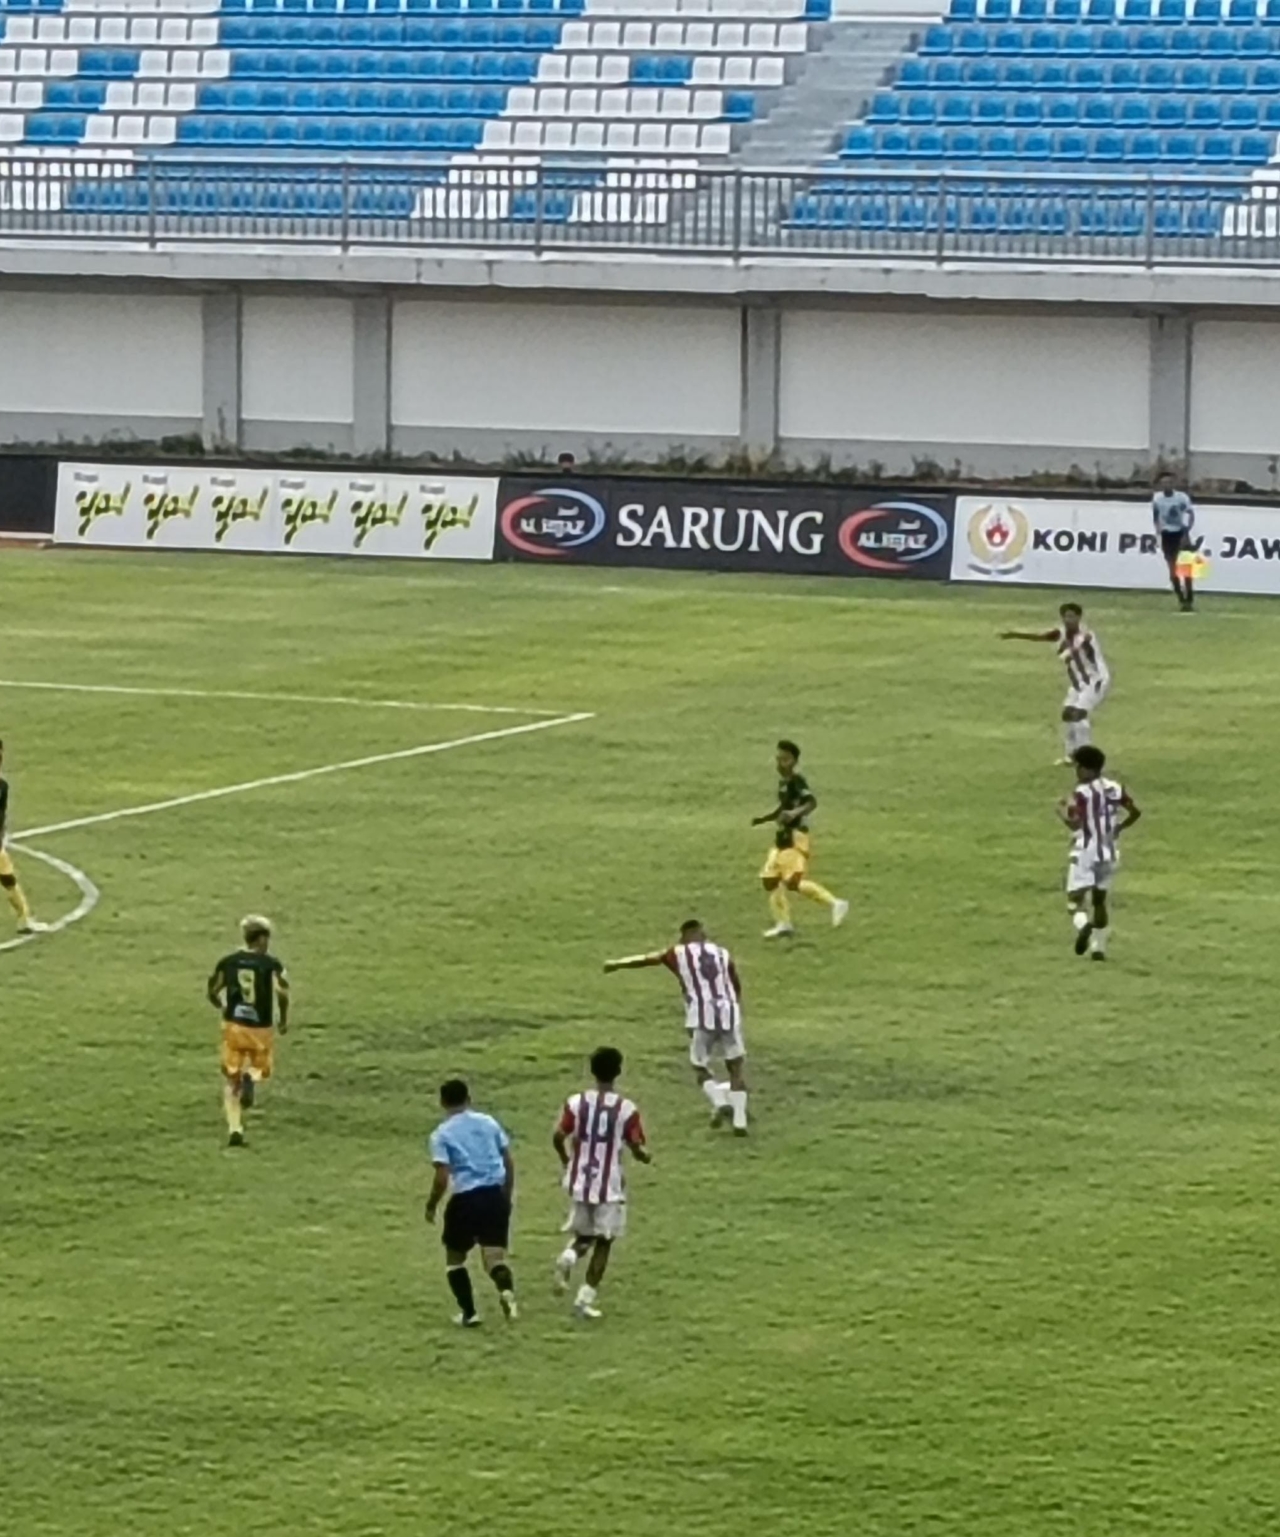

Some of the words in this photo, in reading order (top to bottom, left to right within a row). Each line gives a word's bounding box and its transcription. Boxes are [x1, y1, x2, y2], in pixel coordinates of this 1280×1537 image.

[616, 503, 824, 555] SARUNG
[1032, 529, 1109, 553] KONI
[1118, 533, 1212, 558] PRV.
